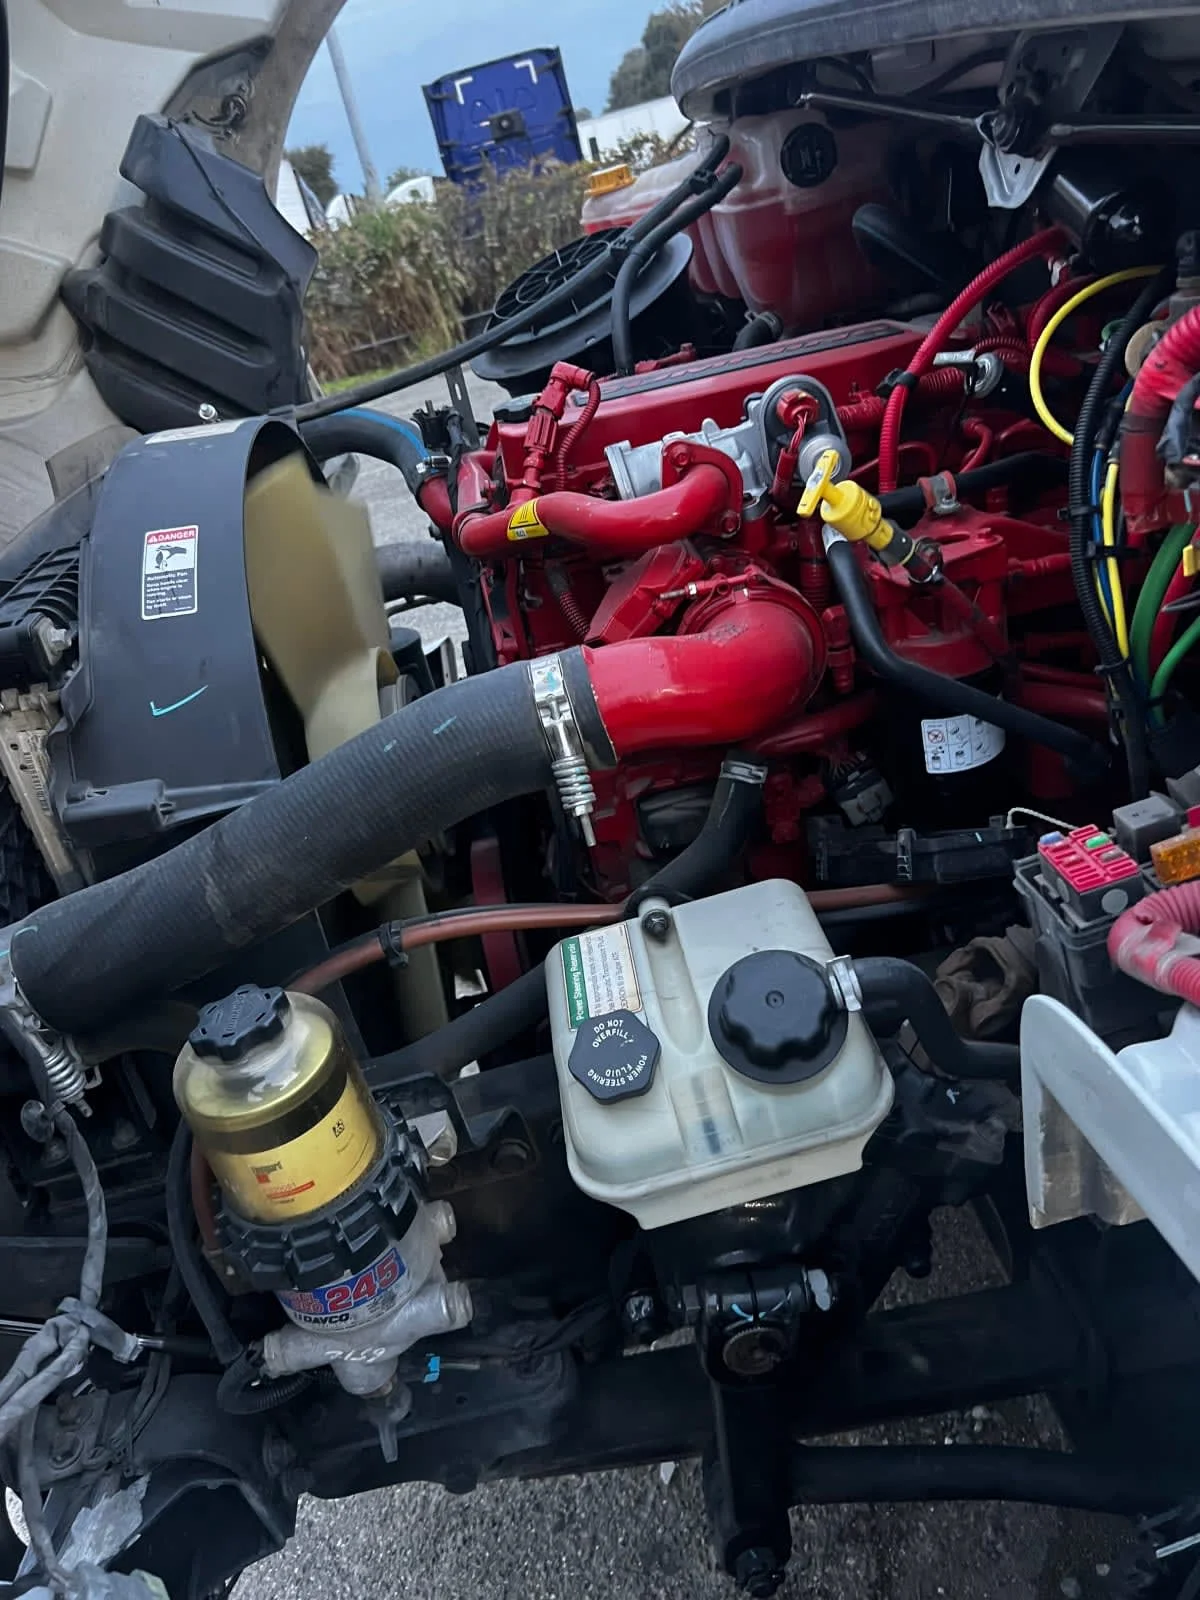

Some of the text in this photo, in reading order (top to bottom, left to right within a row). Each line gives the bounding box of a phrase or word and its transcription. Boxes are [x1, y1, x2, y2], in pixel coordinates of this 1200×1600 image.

[158, 530, 195, 542] DANGER
[147, 573, 176, 581] Automatic
[570, 943, 585, 1021] Power Steering Reservoir
[593, 1019, 624, 1034] DO NOT
[587, 1055, 648, 1087] POWER STEERING
[605, 1063, 633, 1078] FLUID
[326, 1253, 399, 1313] 245
